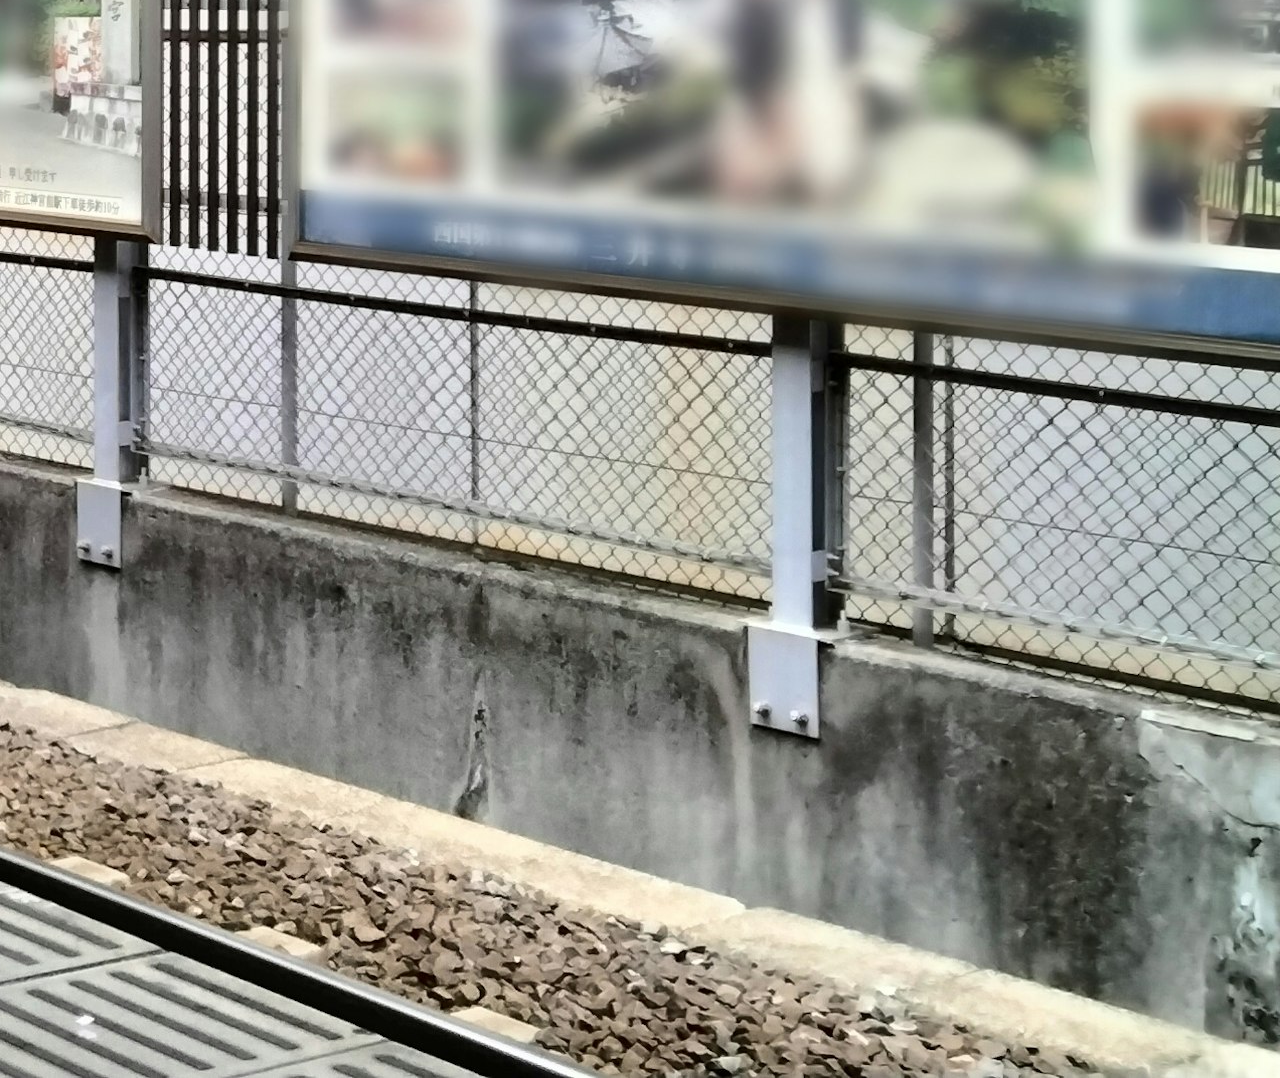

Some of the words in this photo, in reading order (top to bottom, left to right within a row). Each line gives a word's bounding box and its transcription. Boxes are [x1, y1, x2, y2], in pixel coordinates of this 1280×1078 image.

[8, 166, 57, 183] 申し受けます
